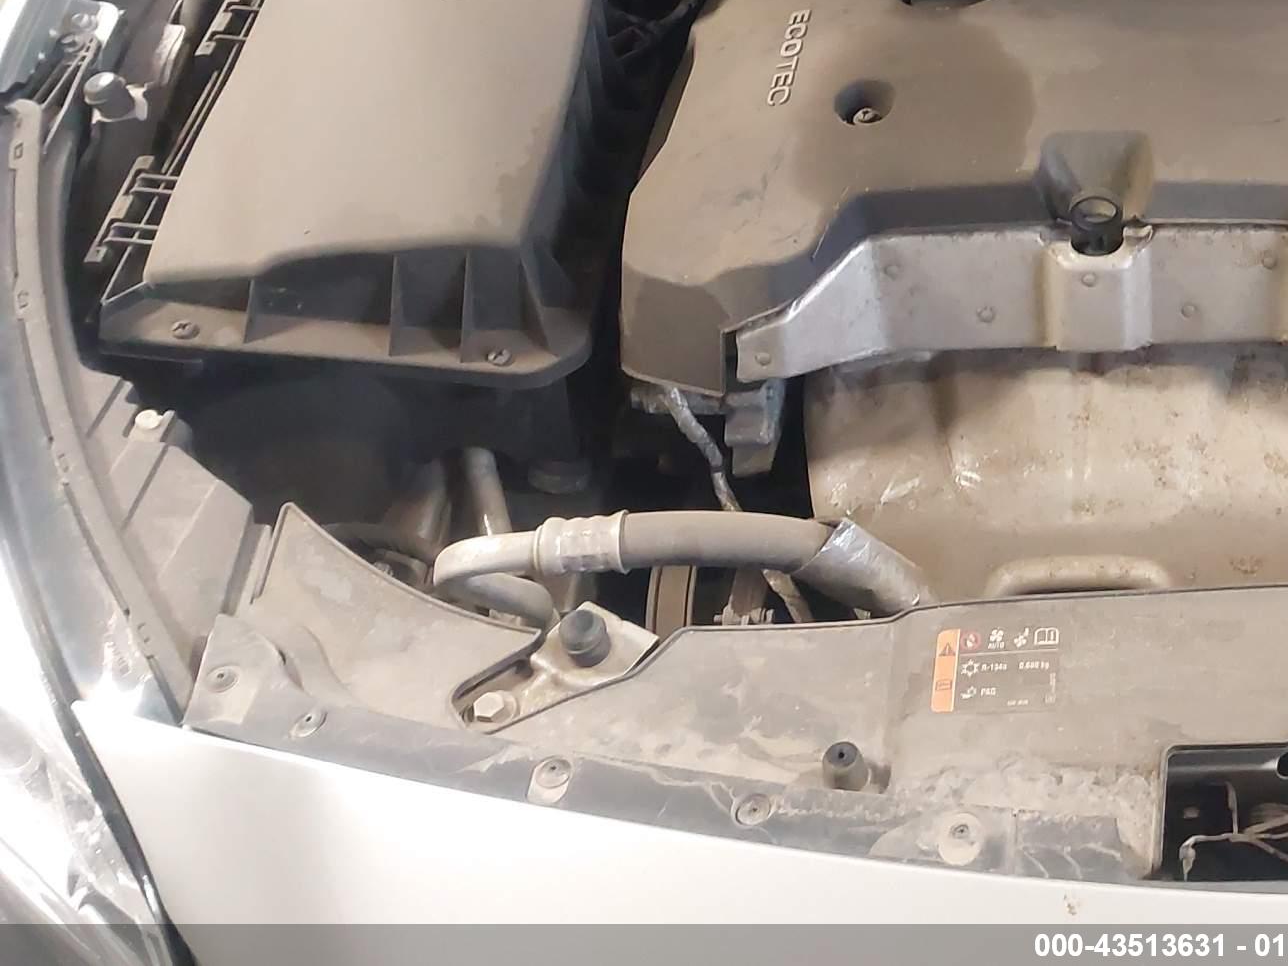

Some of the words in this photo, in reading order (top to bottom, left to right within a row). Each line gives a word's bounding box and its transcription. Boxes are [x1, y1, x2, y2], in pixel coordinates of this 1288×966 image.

[767, 9, 811, 106] ECOTEC
[987, 642, 1005, 650] AUTO
[980, 687, 997, 696] PAG
